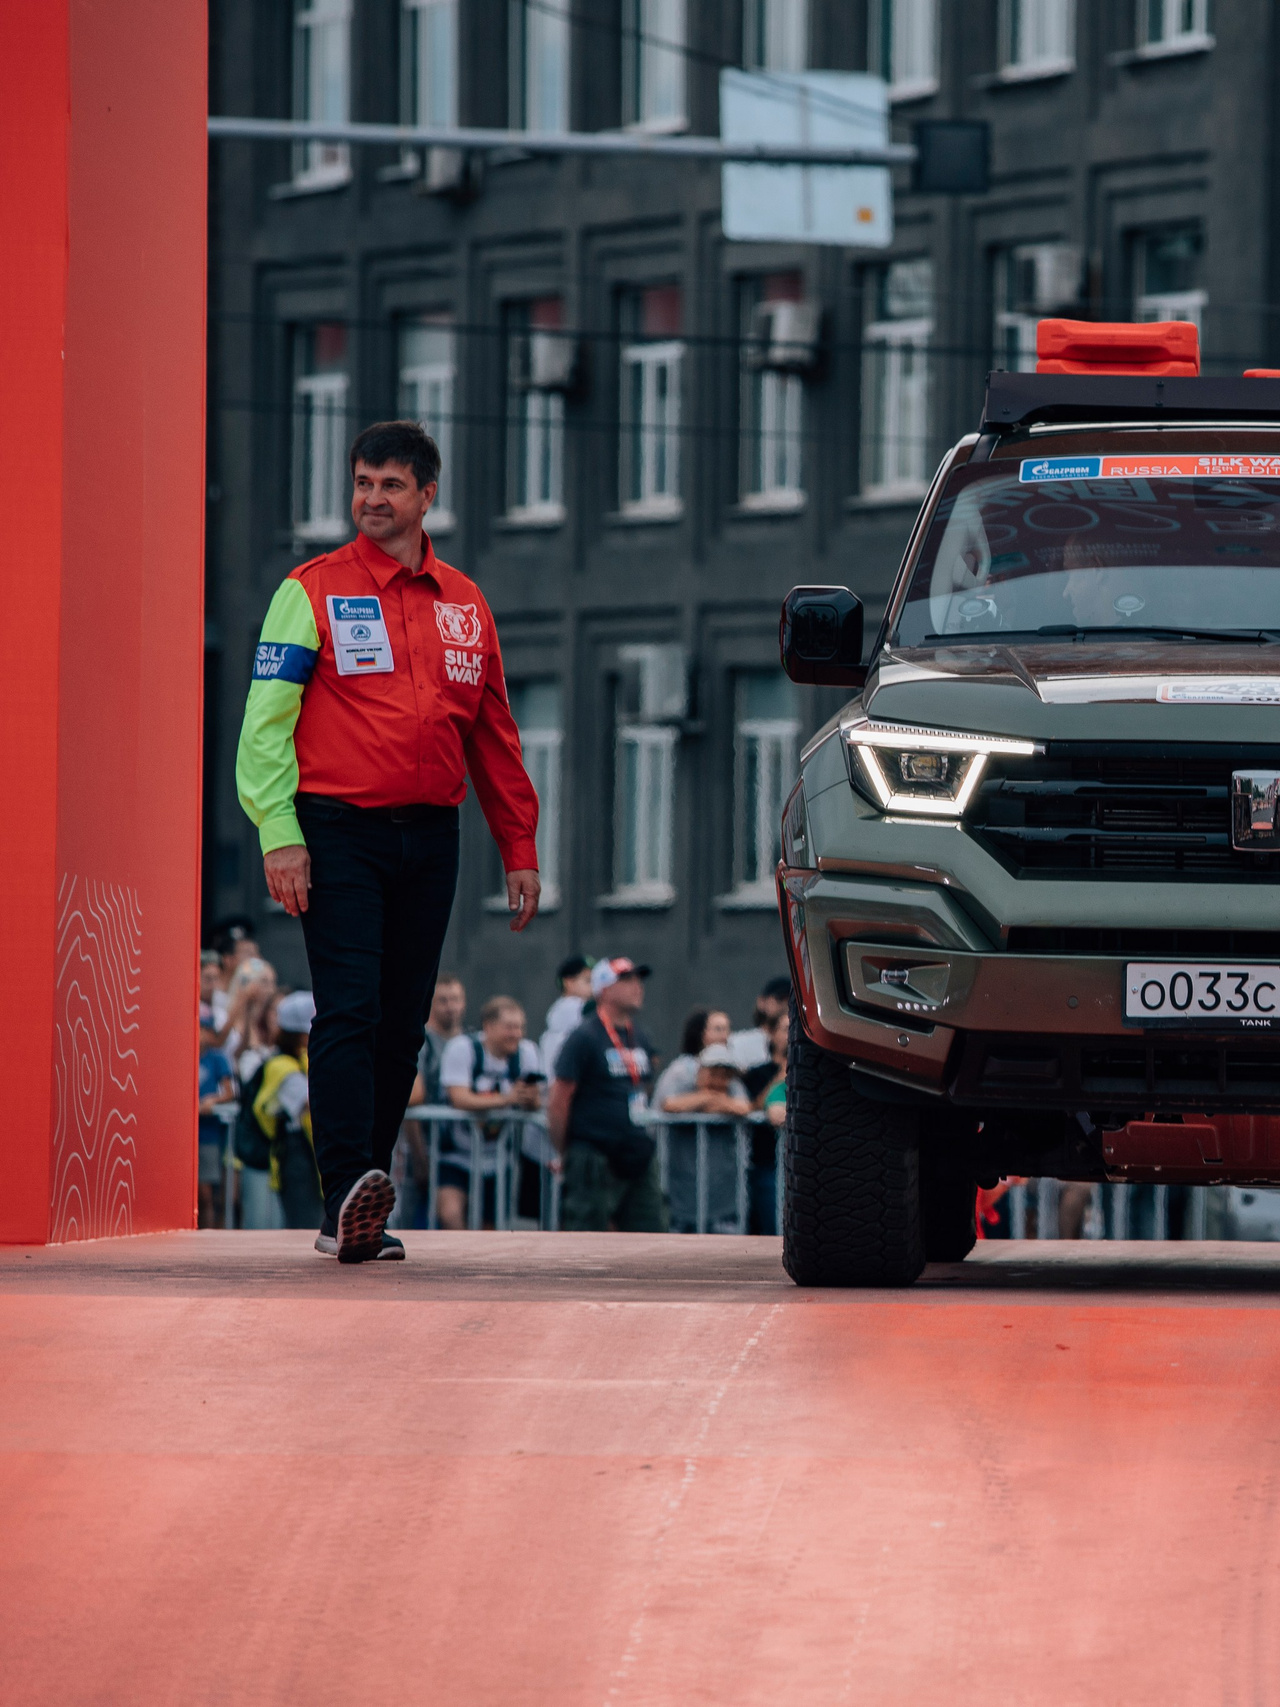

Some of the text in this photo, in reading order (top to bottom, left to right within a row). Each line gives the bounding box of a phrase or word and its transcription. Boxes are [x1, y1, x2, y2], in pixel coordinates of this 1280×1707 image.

[1198, 457, 1243, 467] SILK
[1048, 466, 1090, 475] GAZPROM
[1110, 466, 1182, 476] RUSSIA
[1203, 465, 1234, 475] 15th
[256, 645, 287, 661] SILK
[444, 649, 483, 672] SILK
[256, 661, 285, 677] WAY
[445, 664, 482, 687] WAY
[1239, 1019, 1272, 1027] TANK
